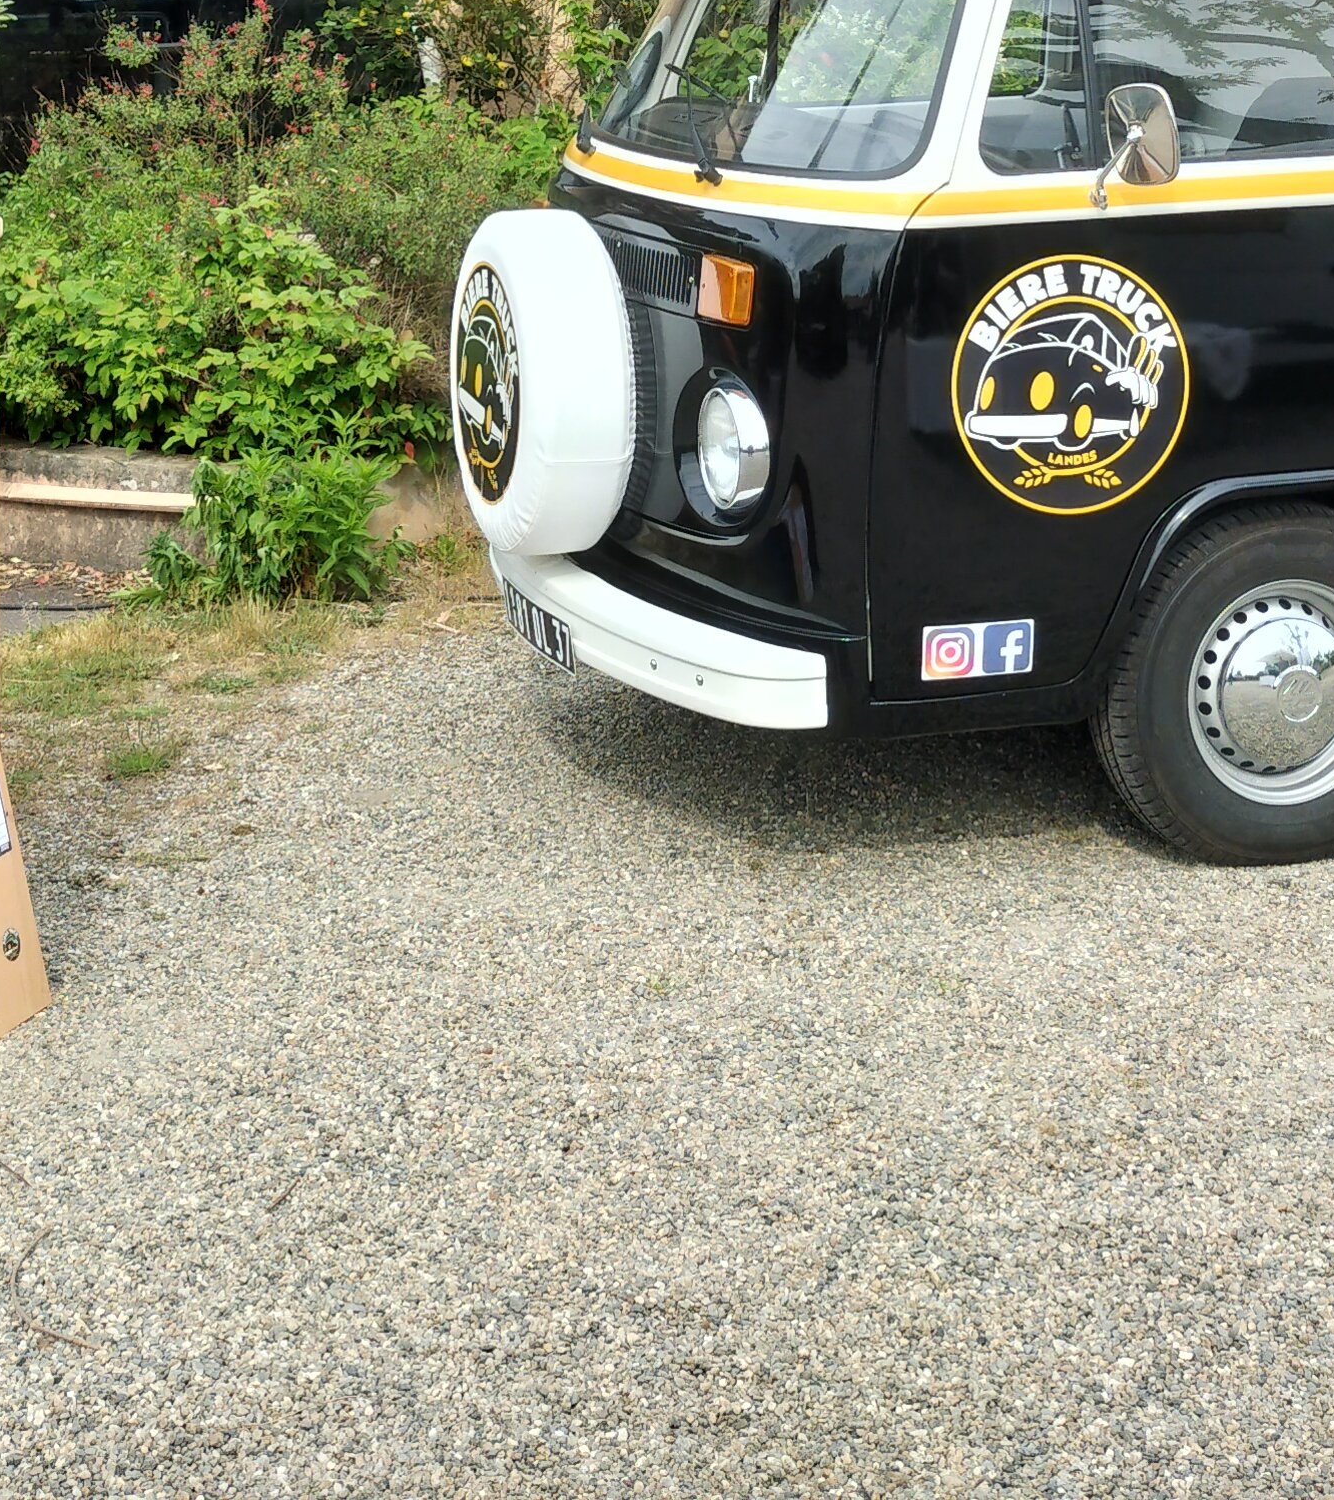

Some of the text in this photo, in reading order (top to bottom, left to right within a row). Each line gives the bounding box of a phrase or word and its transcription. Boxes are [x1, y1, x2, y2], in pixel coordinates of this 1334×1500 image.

[460, 269, 519, 377] BIERE TRUCK
[968, 264, 1178, 352] BIERE TRUCK
[1047, 450, 1097, 467] LANDES
[552, 617, 571, 668] 37
